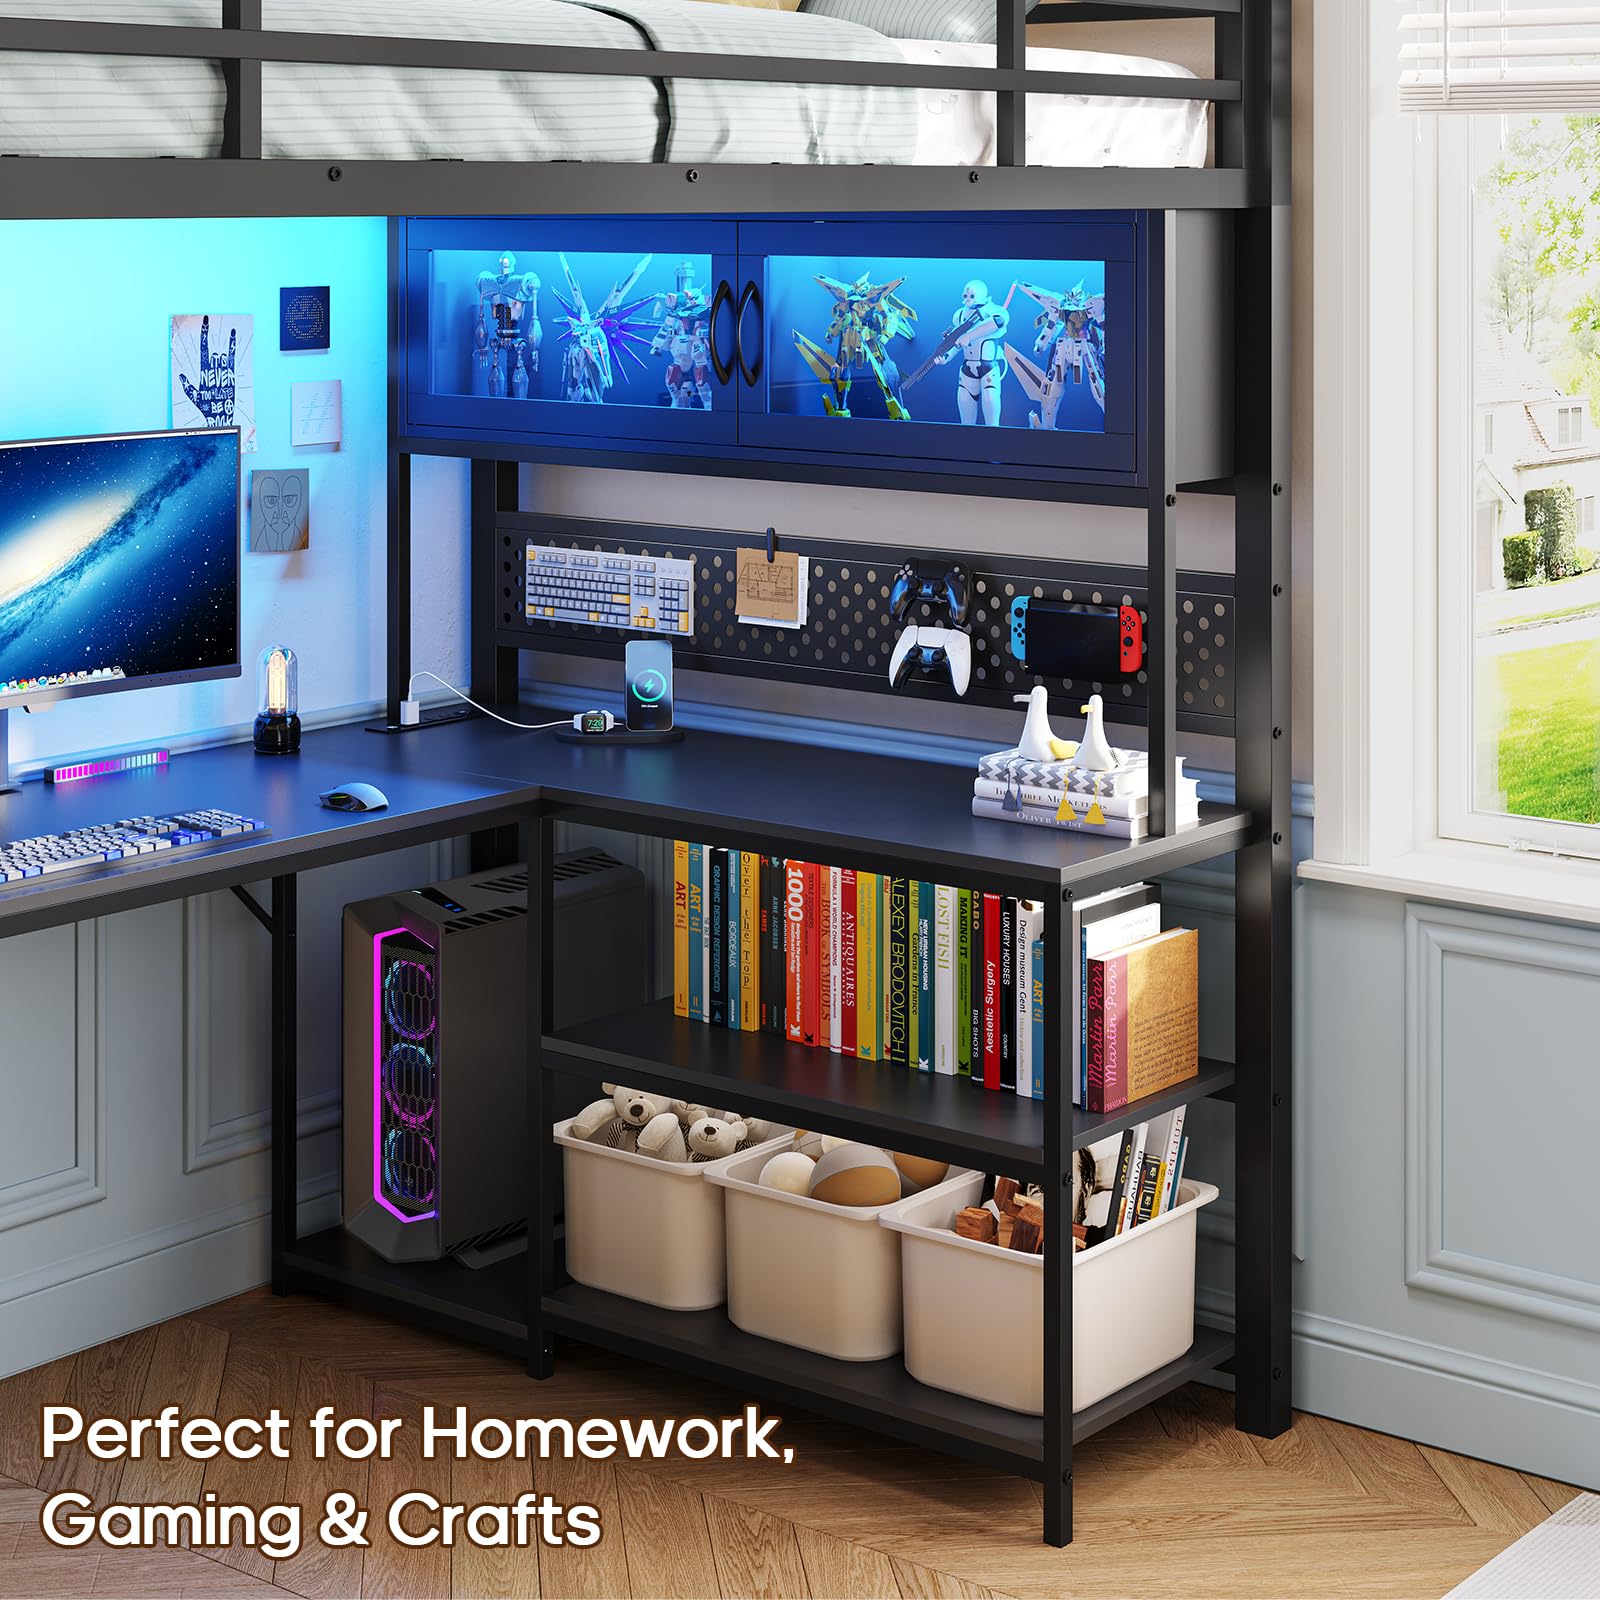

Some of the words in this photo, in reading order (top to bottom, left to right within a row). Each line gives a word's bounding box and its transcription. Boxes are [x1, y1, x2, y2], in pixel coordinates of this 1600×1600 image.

[201, 368, 236, 388] NEVER
[1016, 811, 1053, 824] OLIVER
[713, 865, 721, 903] GRAPHIC
[743, 853, 751, 896] Over
[675, 881, 687, 910] ART
[690, 884, 701, 912] ART
[788, 868, 804, 922] 1000
[937, 886, 950, 931] LOST
[713, 905, 721, 936] DESIGN
[821, 899, 831, 937] BOOK
[960, 896, 968, 944] MAKING
[1003, 911, 1011, 947] LUXURY
[1018, 919, 1028, 950] Design
[729, 920, 737, 967] BORDEAUX
[845, 911, 855, 1007] ANTIQUAIRES
[937, 932, 950, 969] FISH
[960, 945, 968, 959] IT
[713, 937, 721, 993] REFERENCED
[743, 950, 751, 987] Top
[985, 960, 996, 1005] Surgery
[1003, 948, 1011, 986] HOUSES
[821, 952, 831, 1021] SYMBOLS
[892, 942, 905, 1054] BRODOVITCH
[1019, 991, 1027, 1014] Gent
[1033, 978, 1044, 1006] ART
[1088, 962, 1103, 1011] Parr
[1104, 960, 1118, 1011] Parr
[1088, 1015, 1103, 1089] Martin
[1104, 1014, 1118, 1088] Martin
